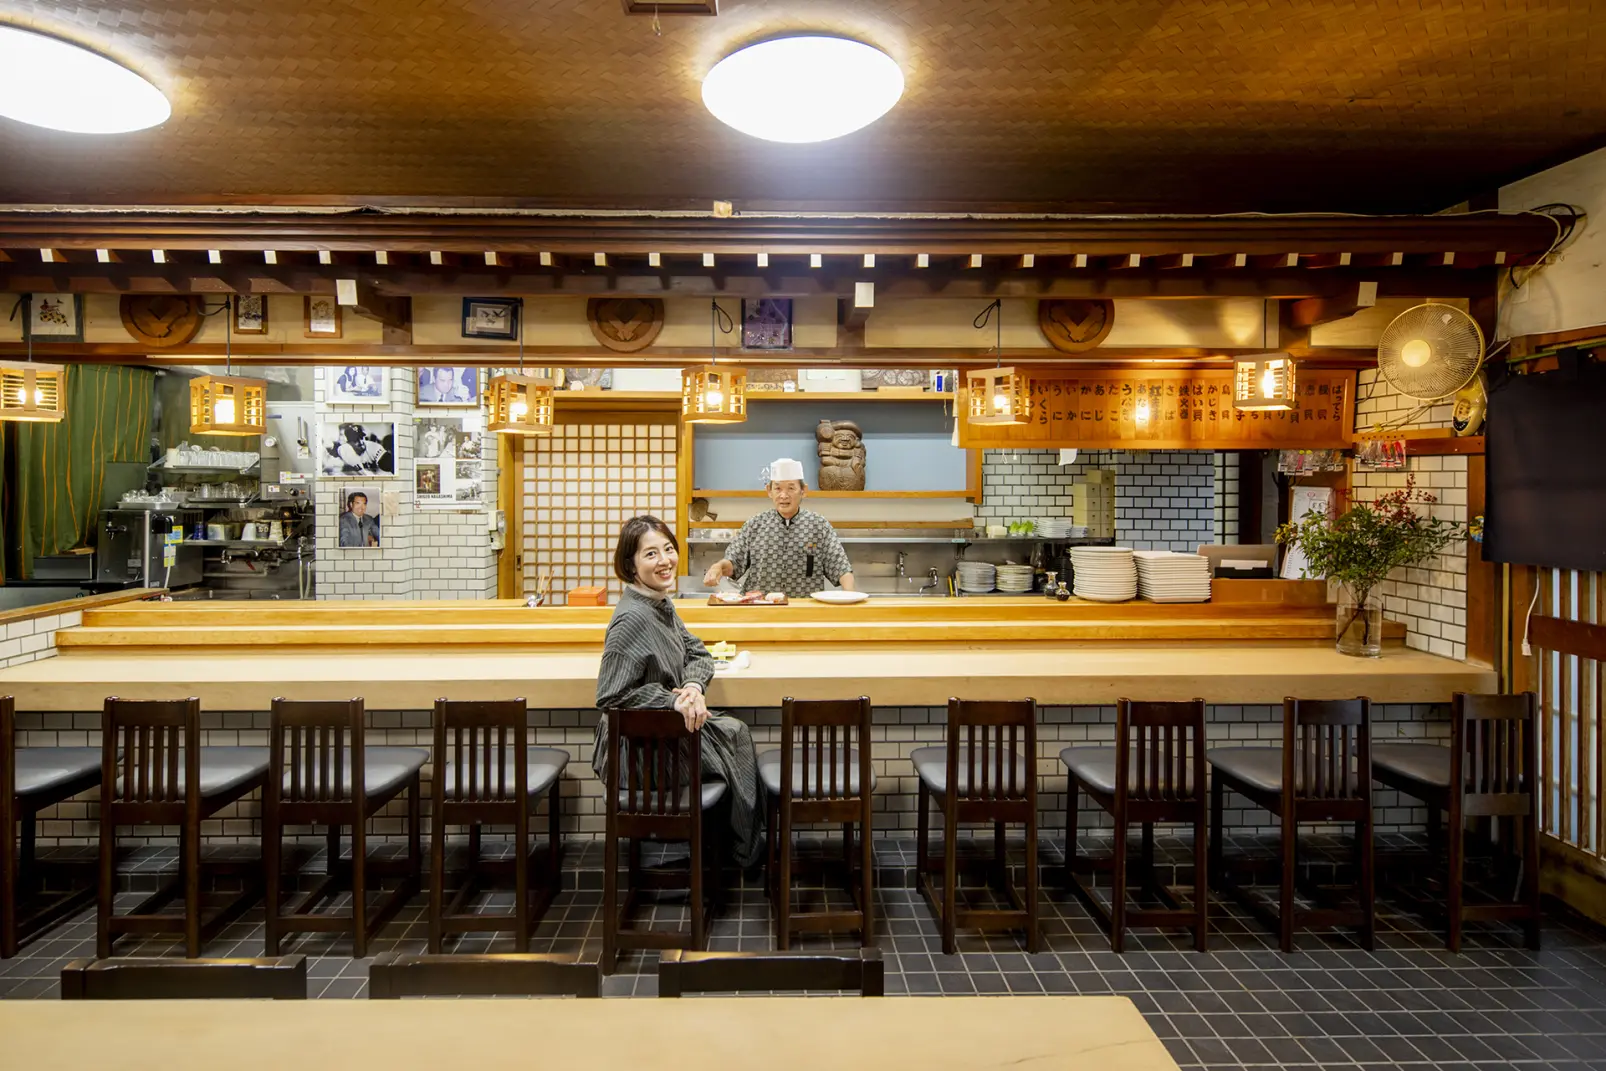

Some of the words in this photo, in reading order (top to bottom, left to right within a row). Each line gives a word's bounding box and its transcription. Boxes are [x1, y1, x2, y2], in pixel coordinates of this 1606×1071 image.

[1037, 384, 1049, 425] いくら
[1053, 385, 1063, 421] うに
[1066, 386, 1077, 421] いか
[1081, 385, 1092, 421] かに
[1095, 384, 1105, 422] あじ
[1108, 384, 1119, 422] たこ
